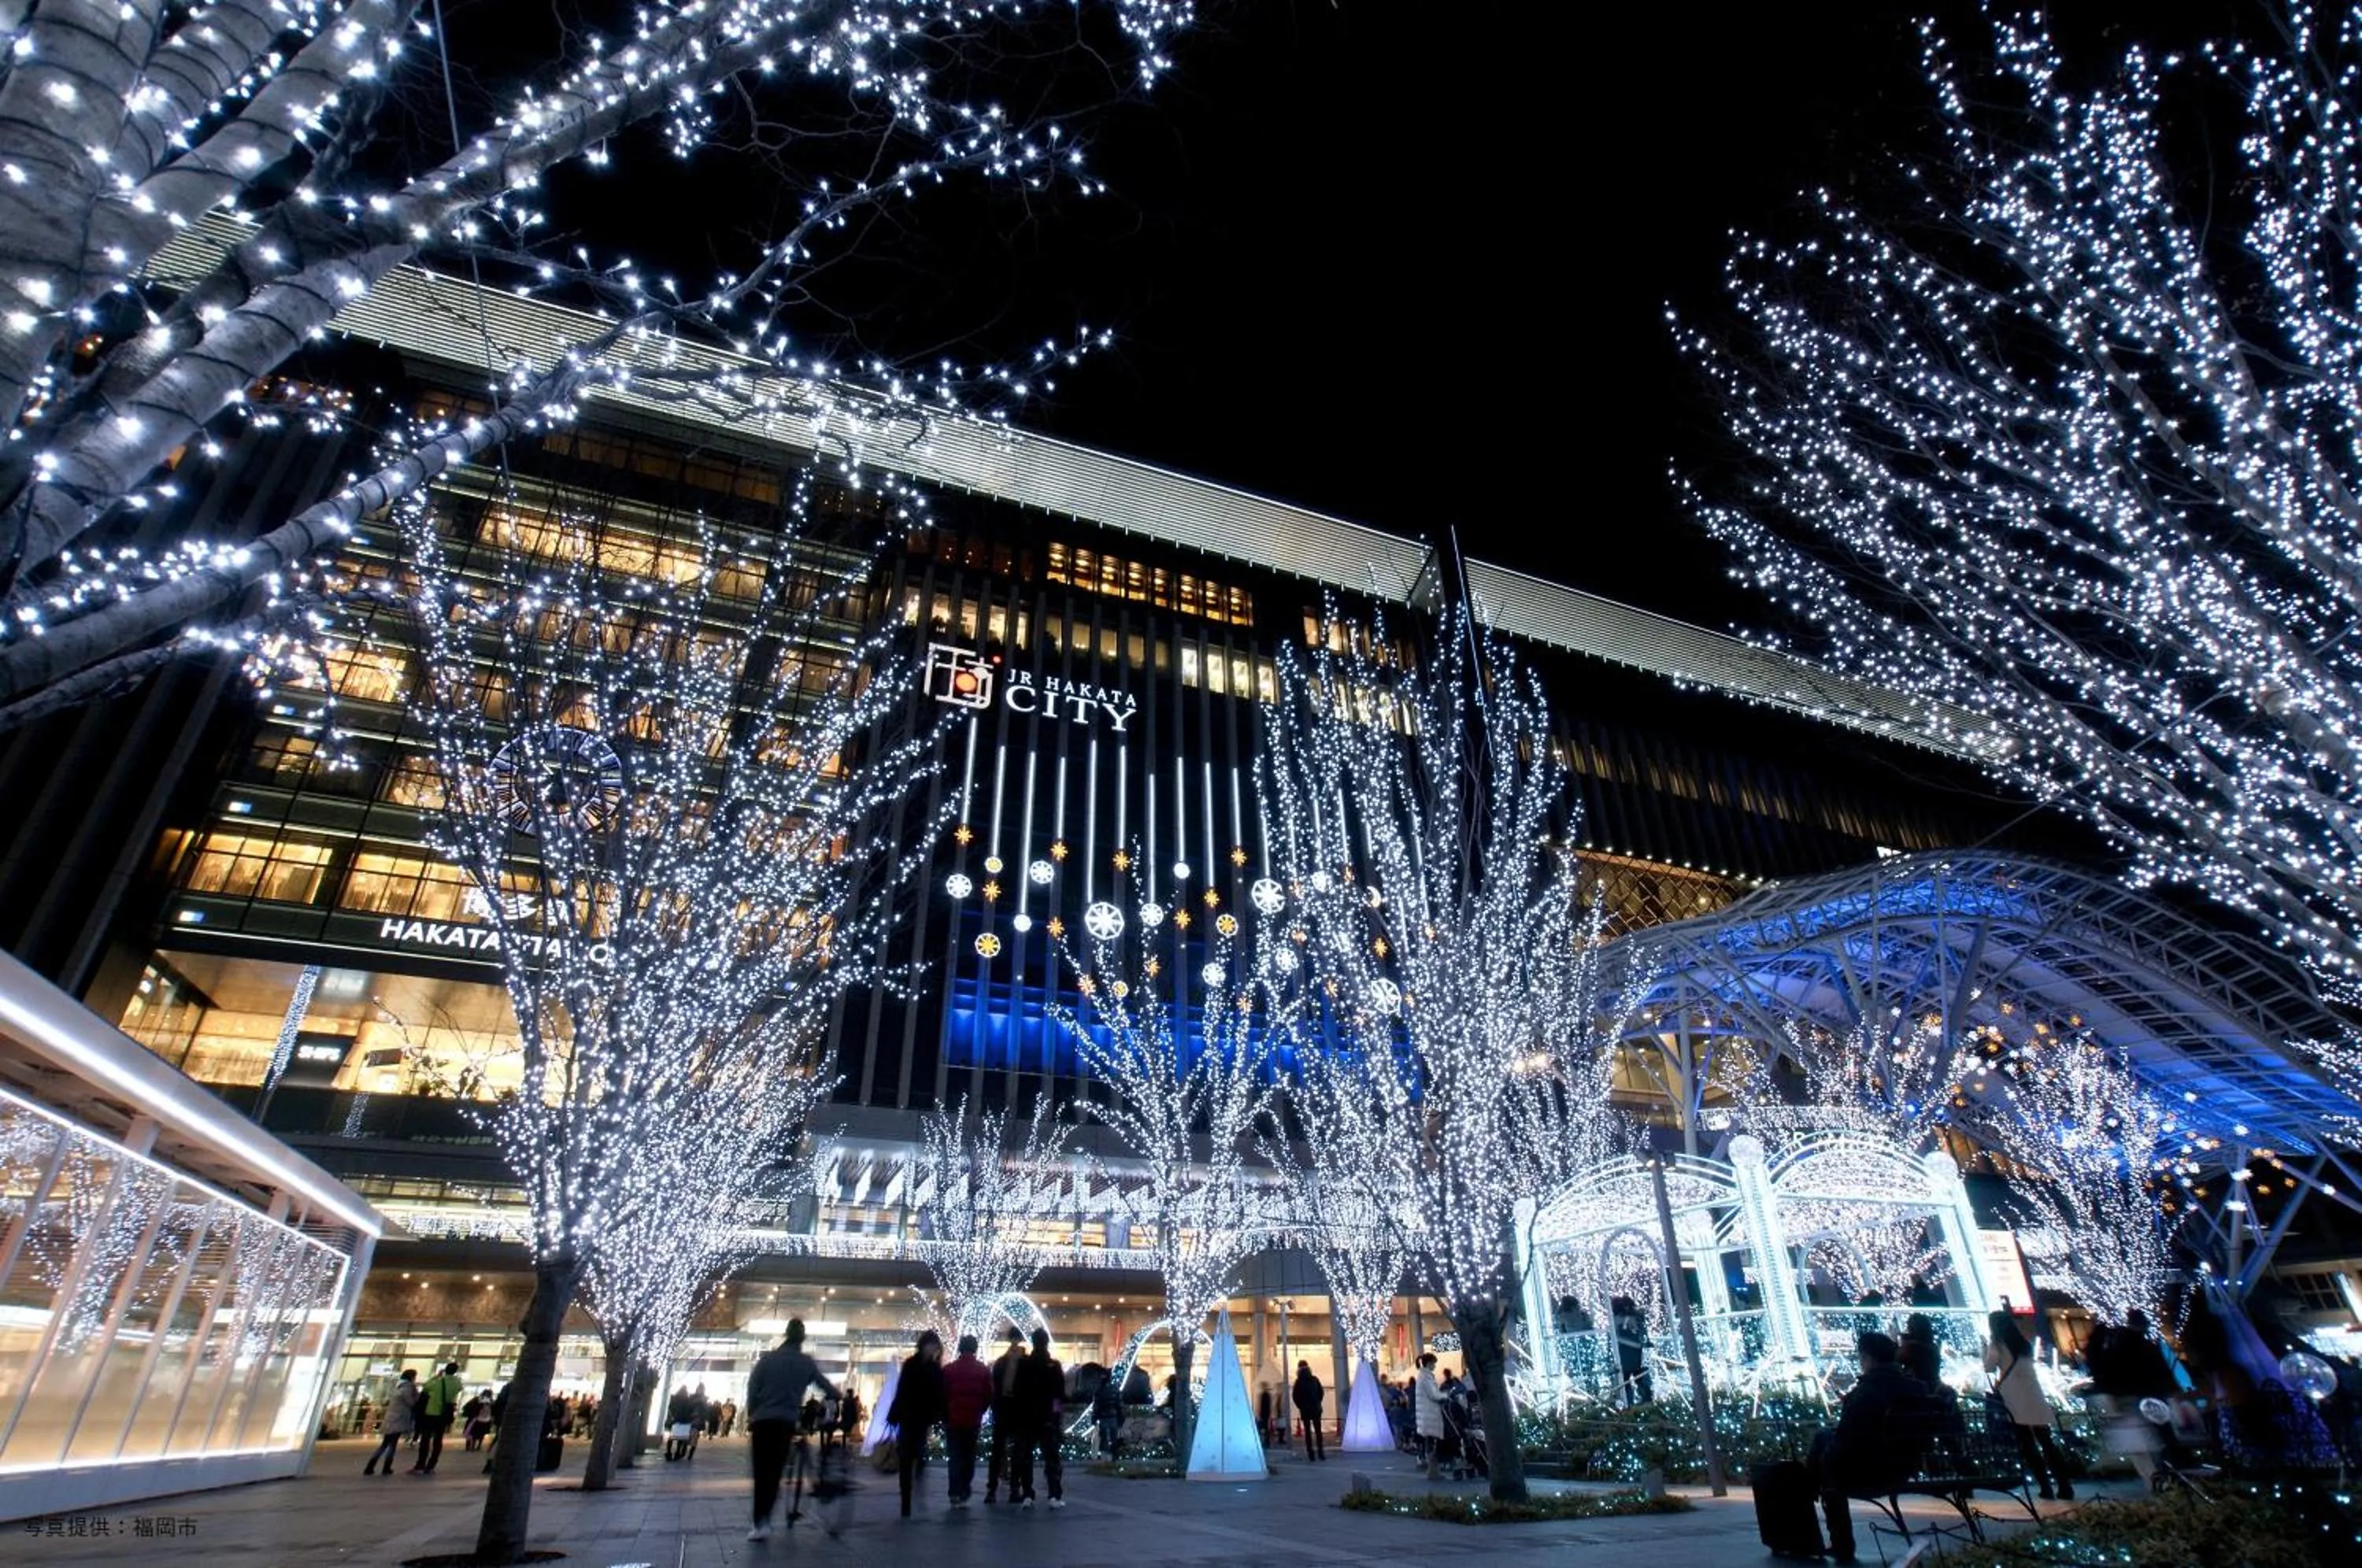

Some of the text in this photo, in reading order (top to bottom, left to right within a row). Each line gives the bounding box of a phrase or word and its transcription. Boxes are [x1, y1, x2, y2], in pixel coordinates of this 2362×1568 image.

[1007, 668, 1137, 708] JR HAKATA
[1005, 685, 1138, 732] CITY
[380, 919, 501, 951] HAKATA
